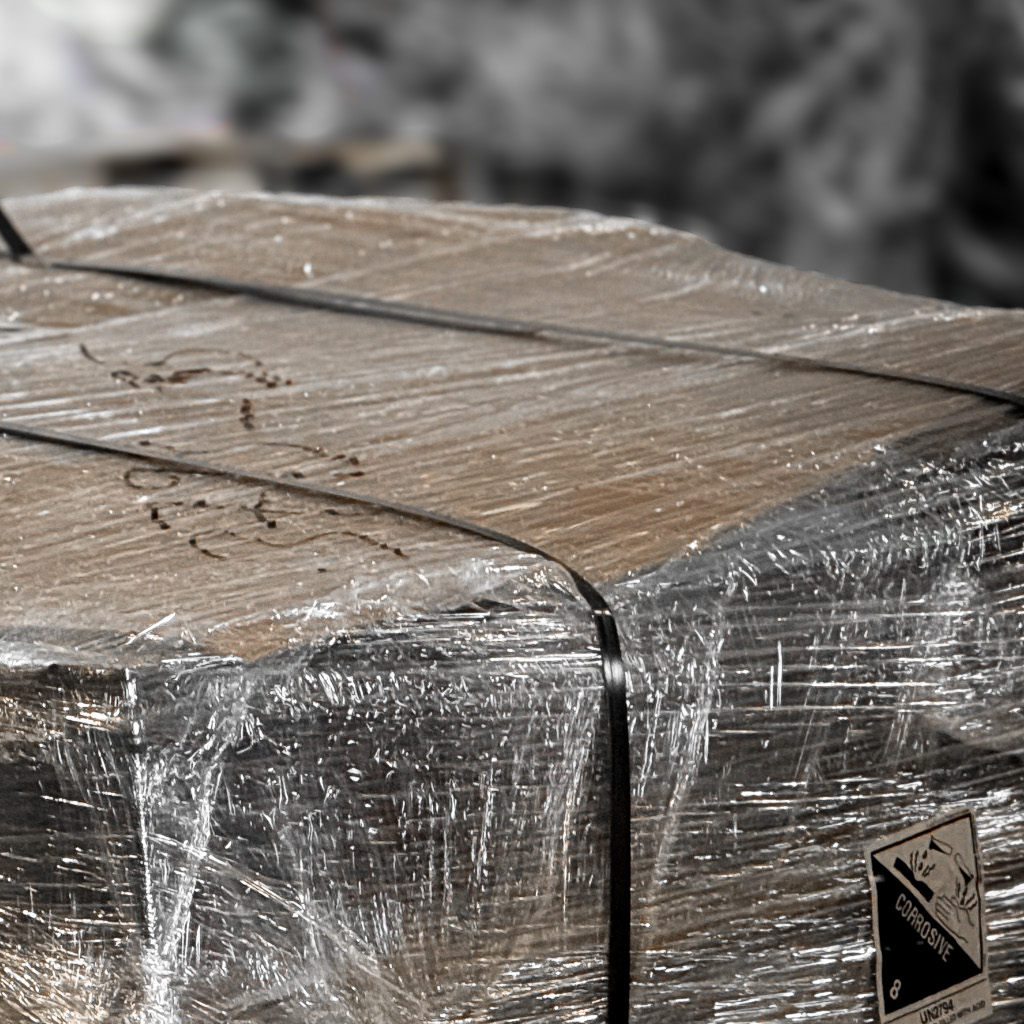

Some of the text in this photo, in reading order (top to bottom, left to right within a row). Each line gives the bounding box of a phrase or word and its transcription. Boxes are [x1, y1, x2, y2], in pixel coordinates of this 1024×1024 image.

[895, 893, 954, 963] CORROSIVE
[890, 979, 902, 1000] 8
[919, 999, 955, 1024] UN2794
